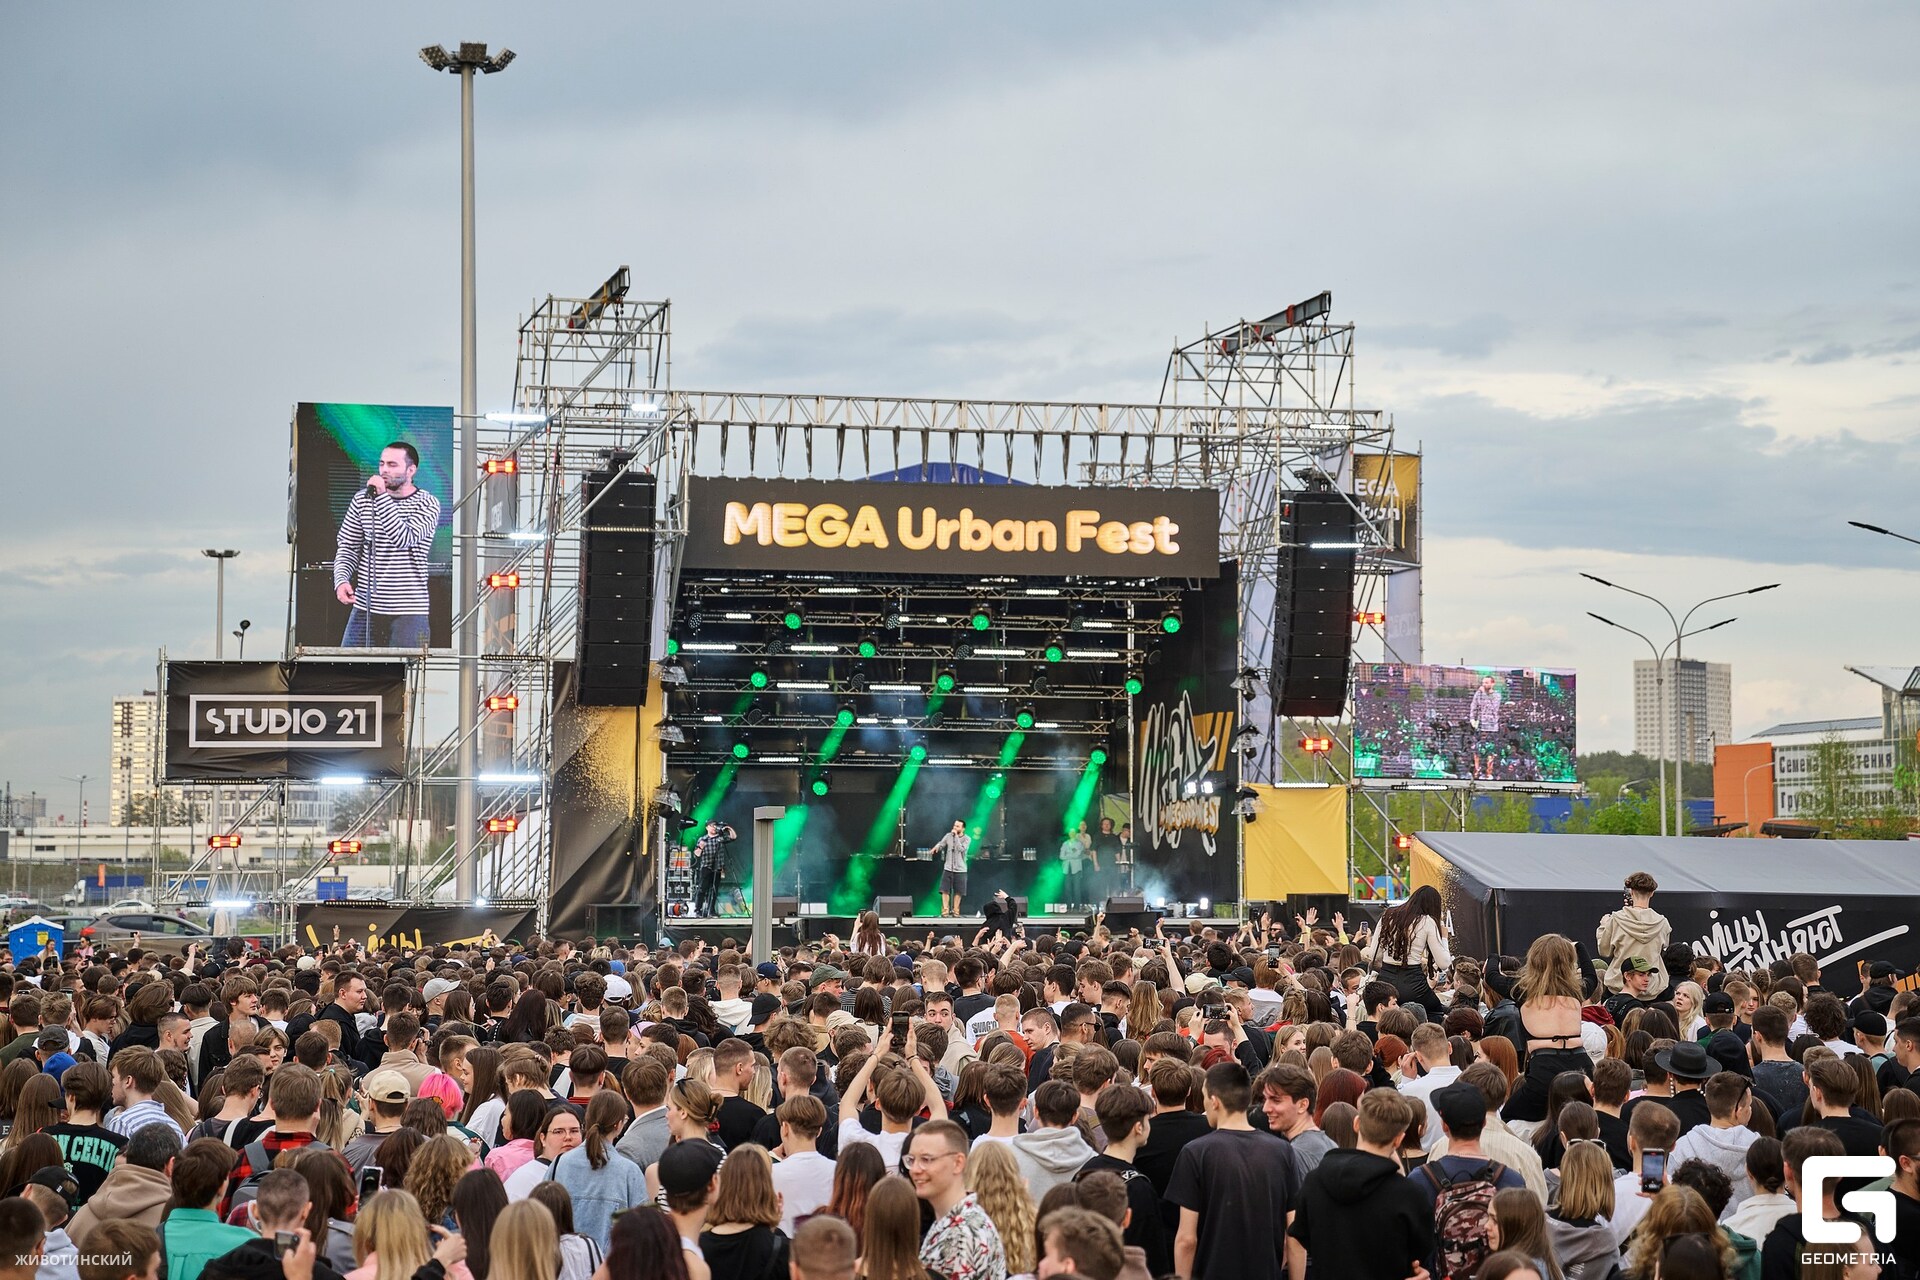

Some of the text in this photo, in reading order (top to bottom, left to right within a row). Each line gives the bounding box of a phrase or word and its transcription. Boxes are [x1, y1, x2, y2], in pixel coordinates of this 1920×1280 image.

[1354, 478, 1400, 497] EGA
[723, 501, 1180, 555] MEGA Urban Fest
[205, 708, 367, 735] STUDIO 21
